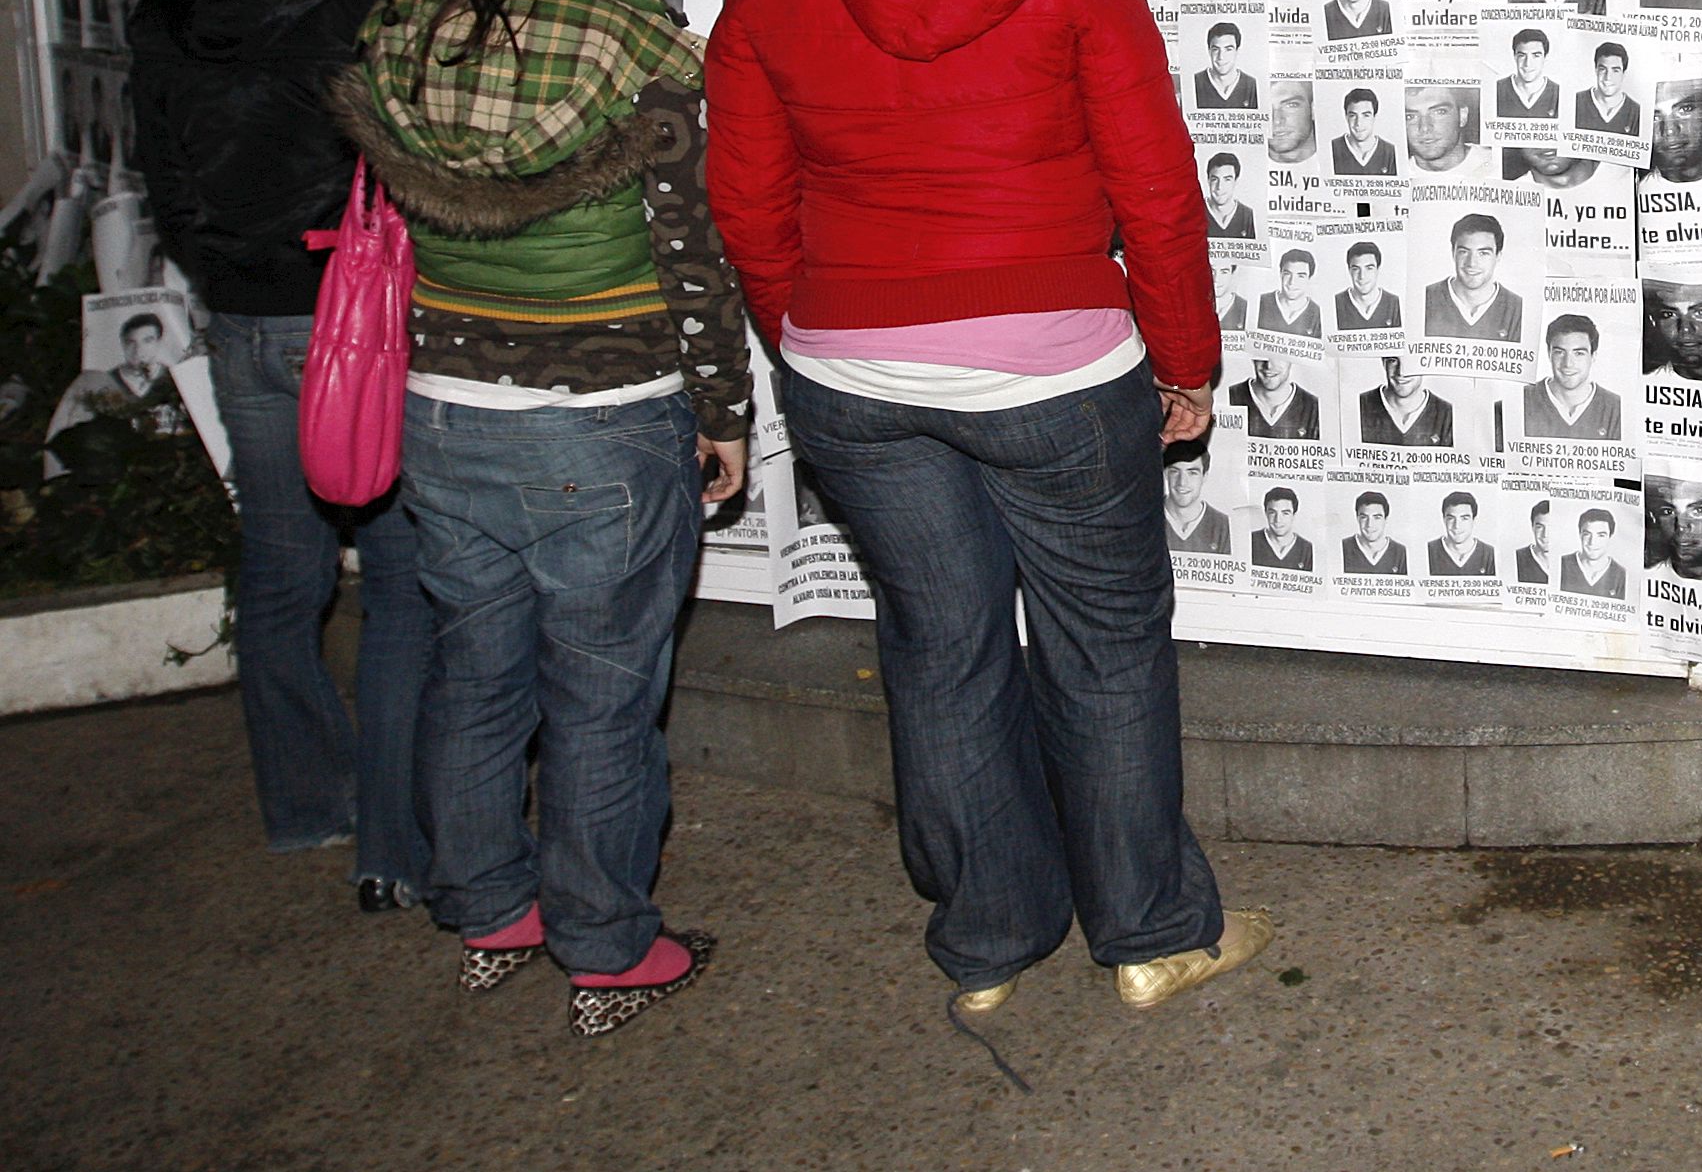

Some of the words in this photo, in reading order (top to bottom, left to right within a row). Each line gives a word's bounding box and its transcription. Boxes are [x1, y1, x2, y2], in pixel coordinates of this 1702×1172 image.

[1640, 192, 1700, 213] USSIA,
[1641, 228, 1658, 243] te
[1408, 343, 1452, 354] VIERNES
[1455, 345, 1469, 357] 21,
[1473, 346, 1498, 357] 20:00
[1502, 348, 1534, 362] HORAS
[1421, 357, 1431, 368] C/
[1436, 357, 1473, 369] PINTOR
[1476, 360, 1522, 374] ROSALES
[1645, 418, 1663, 433] te
[1647, 579, 1702, 609] USSIA,
[1647, 611, 1664, 627] te
